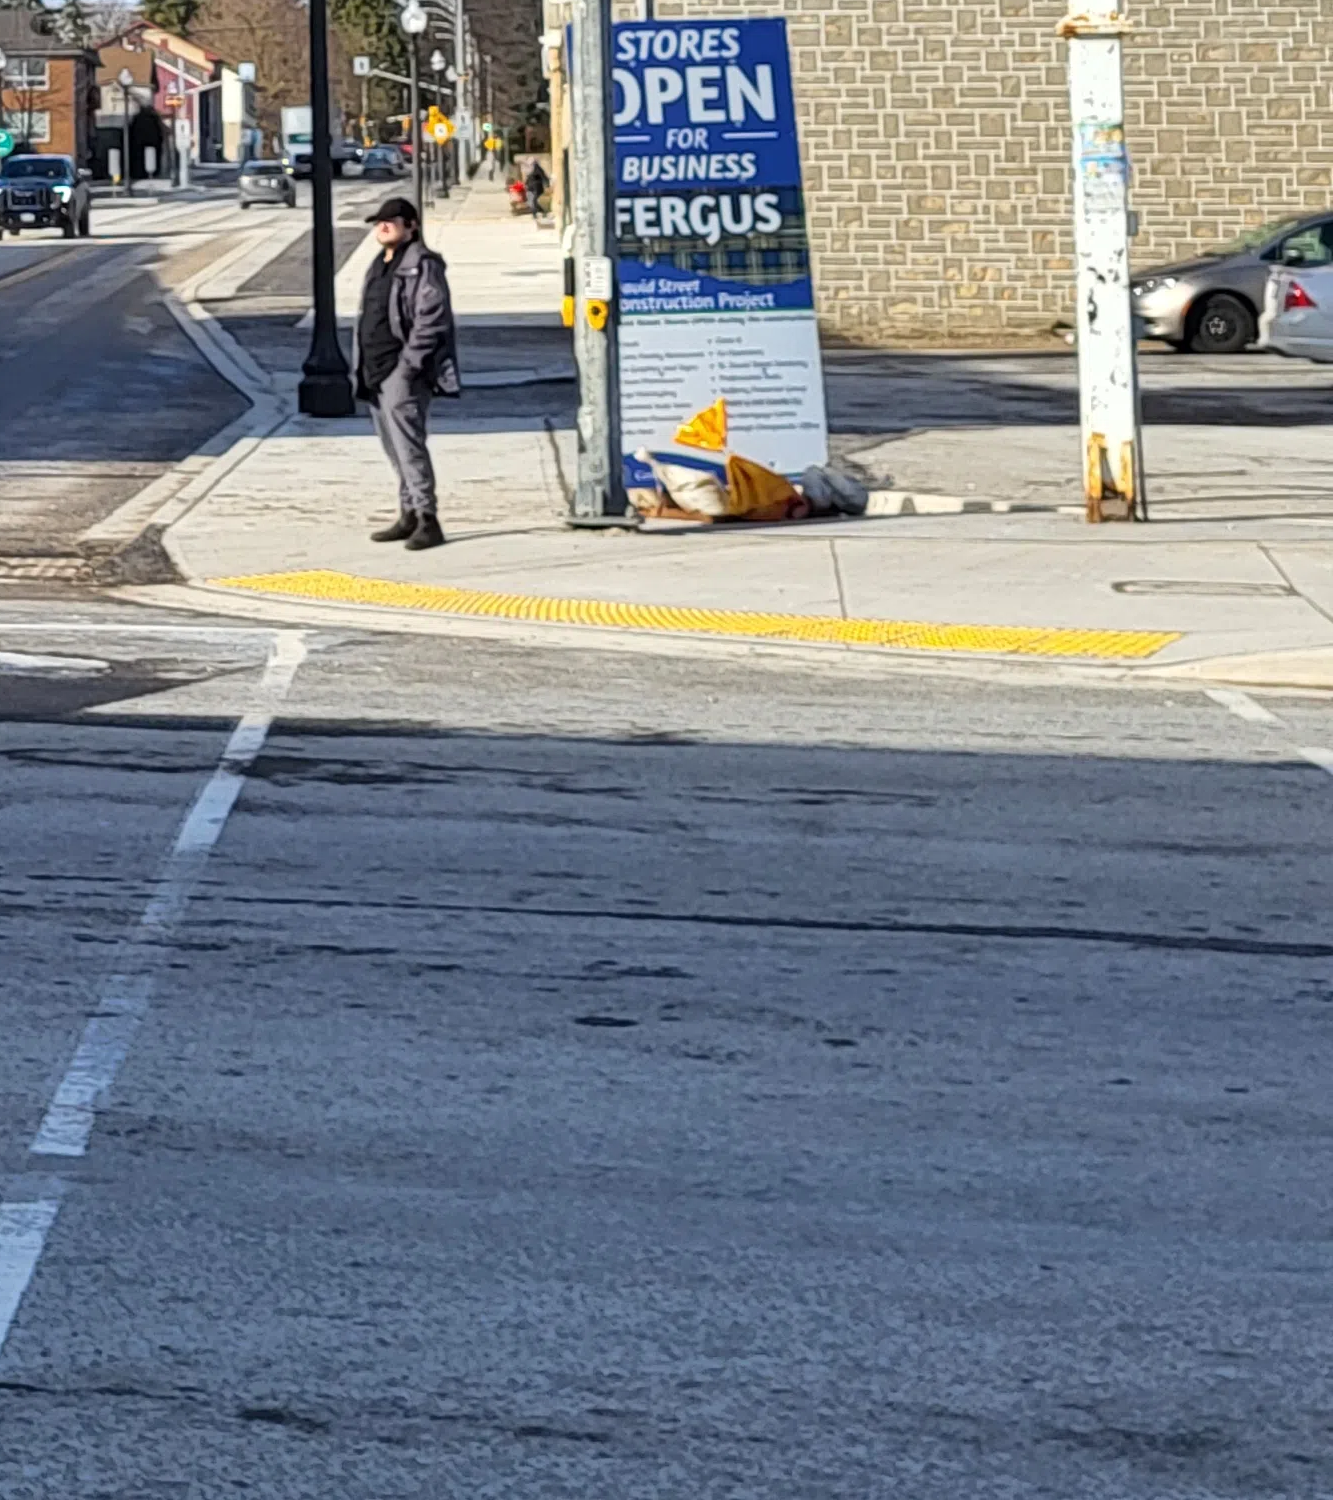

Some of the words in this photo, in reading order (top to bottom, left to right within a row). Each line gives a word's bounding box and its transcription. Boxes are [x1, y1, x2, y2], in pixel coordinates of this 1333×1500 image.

[615, 27, 741, 63] STORES
[665, 127, 709, 150] FOR
[622, 153, 757, 182] BUSINESS
[614, 193, 783, 246] FERGUS
[620, 278, 656, 295] avid
[657, 278, 701, 294] Street
[619, 295, 715, 311] onstruction
[717, 291, 776, 309] Project
